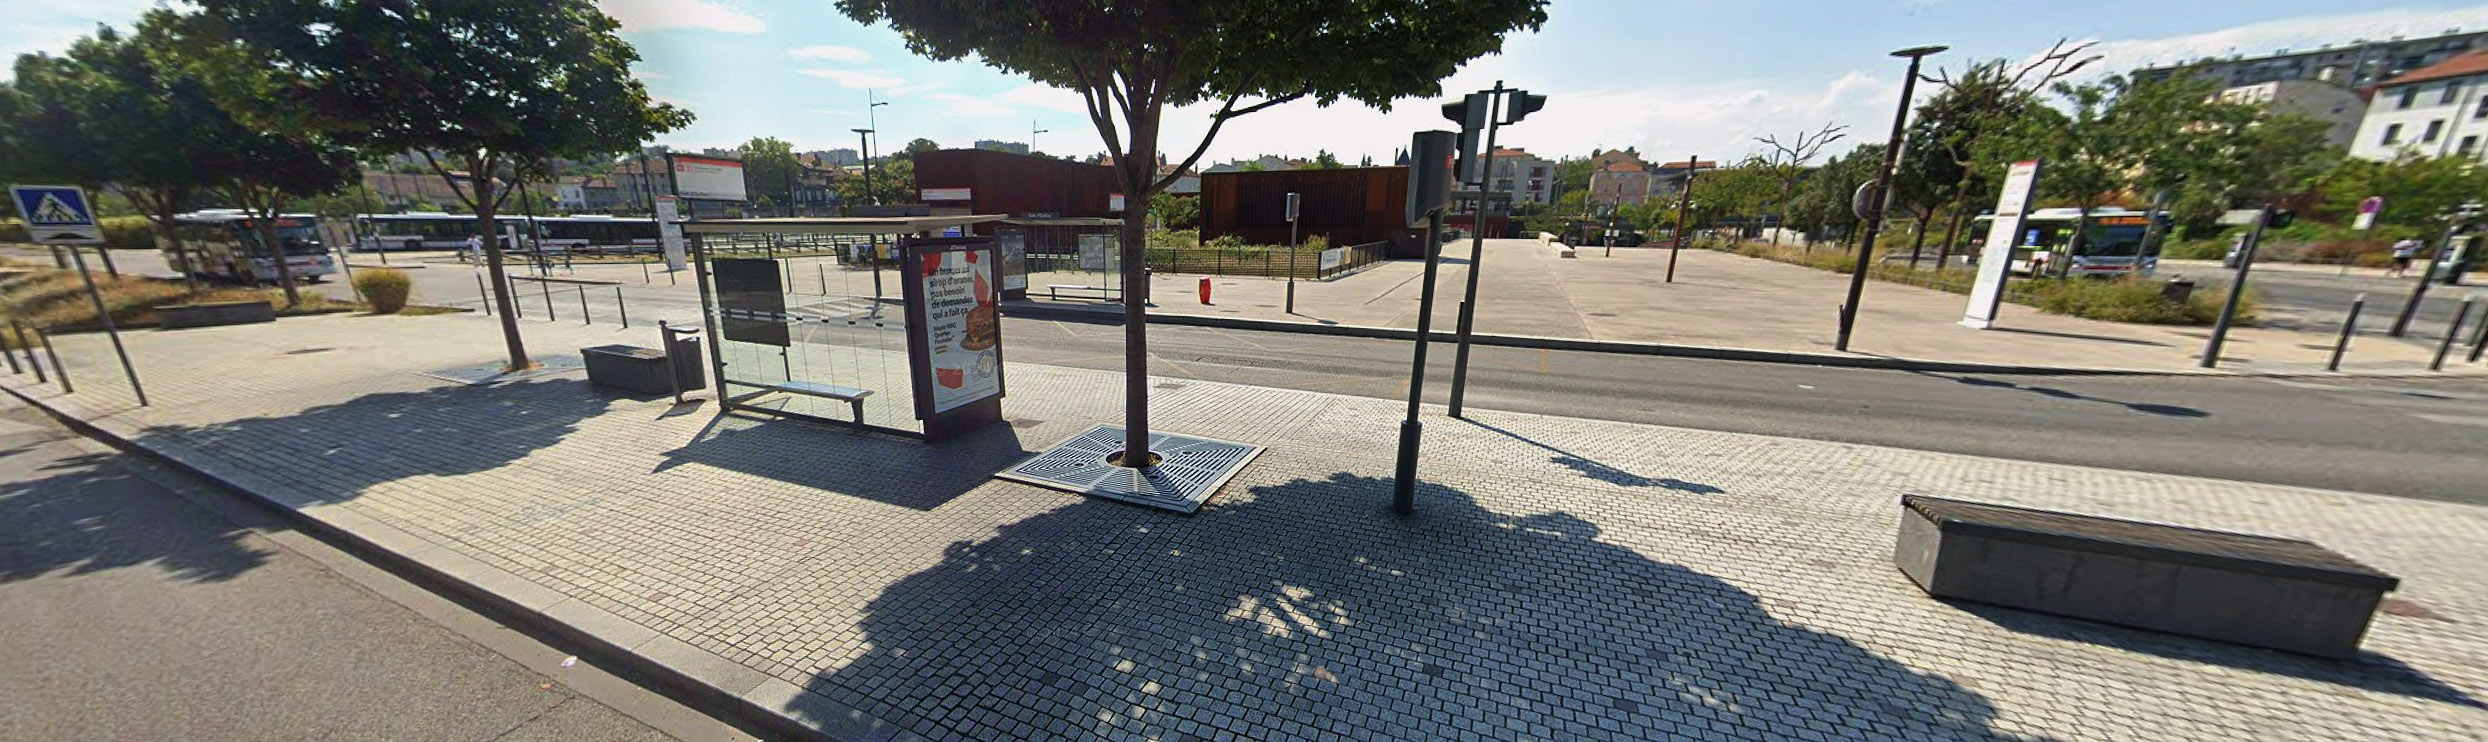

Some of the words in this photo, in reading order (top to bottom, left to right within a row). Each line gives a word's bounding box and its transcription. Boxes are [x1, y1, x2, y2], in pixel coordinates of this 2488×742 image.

[930, 290, 943, 300] pas
[944, 286, 966, 297] besoin
[932, 300, 940, 309] de
[941, 296, 973, 307] demander
[933, 309, 943, 321] qui
[949, 307, 960, 316] fait
